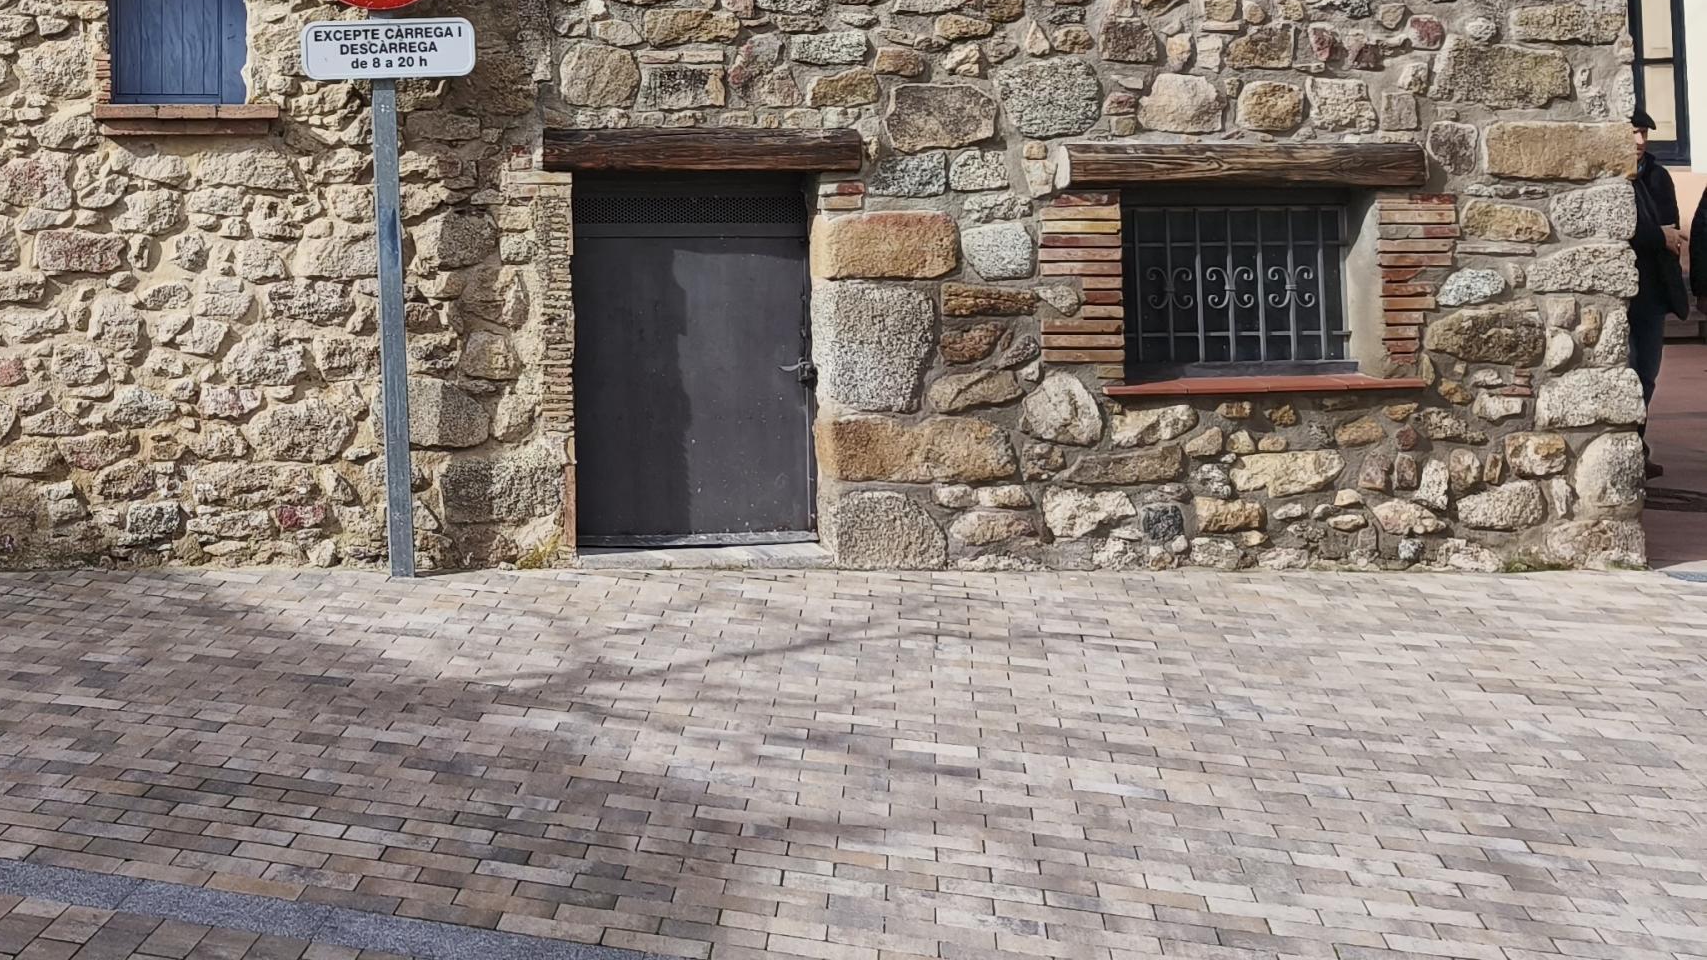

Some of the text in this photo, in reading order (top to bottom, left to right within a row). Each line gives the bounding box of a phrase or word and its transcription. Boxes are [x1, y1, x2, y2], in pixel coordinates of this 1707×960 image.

[314, 25, 462, 42] EXCEPTE CÀRREGA I
[340, 40, 438, 55] DESCÀRREGA
[351, 56, 428, 69] de 8 a 20 h
